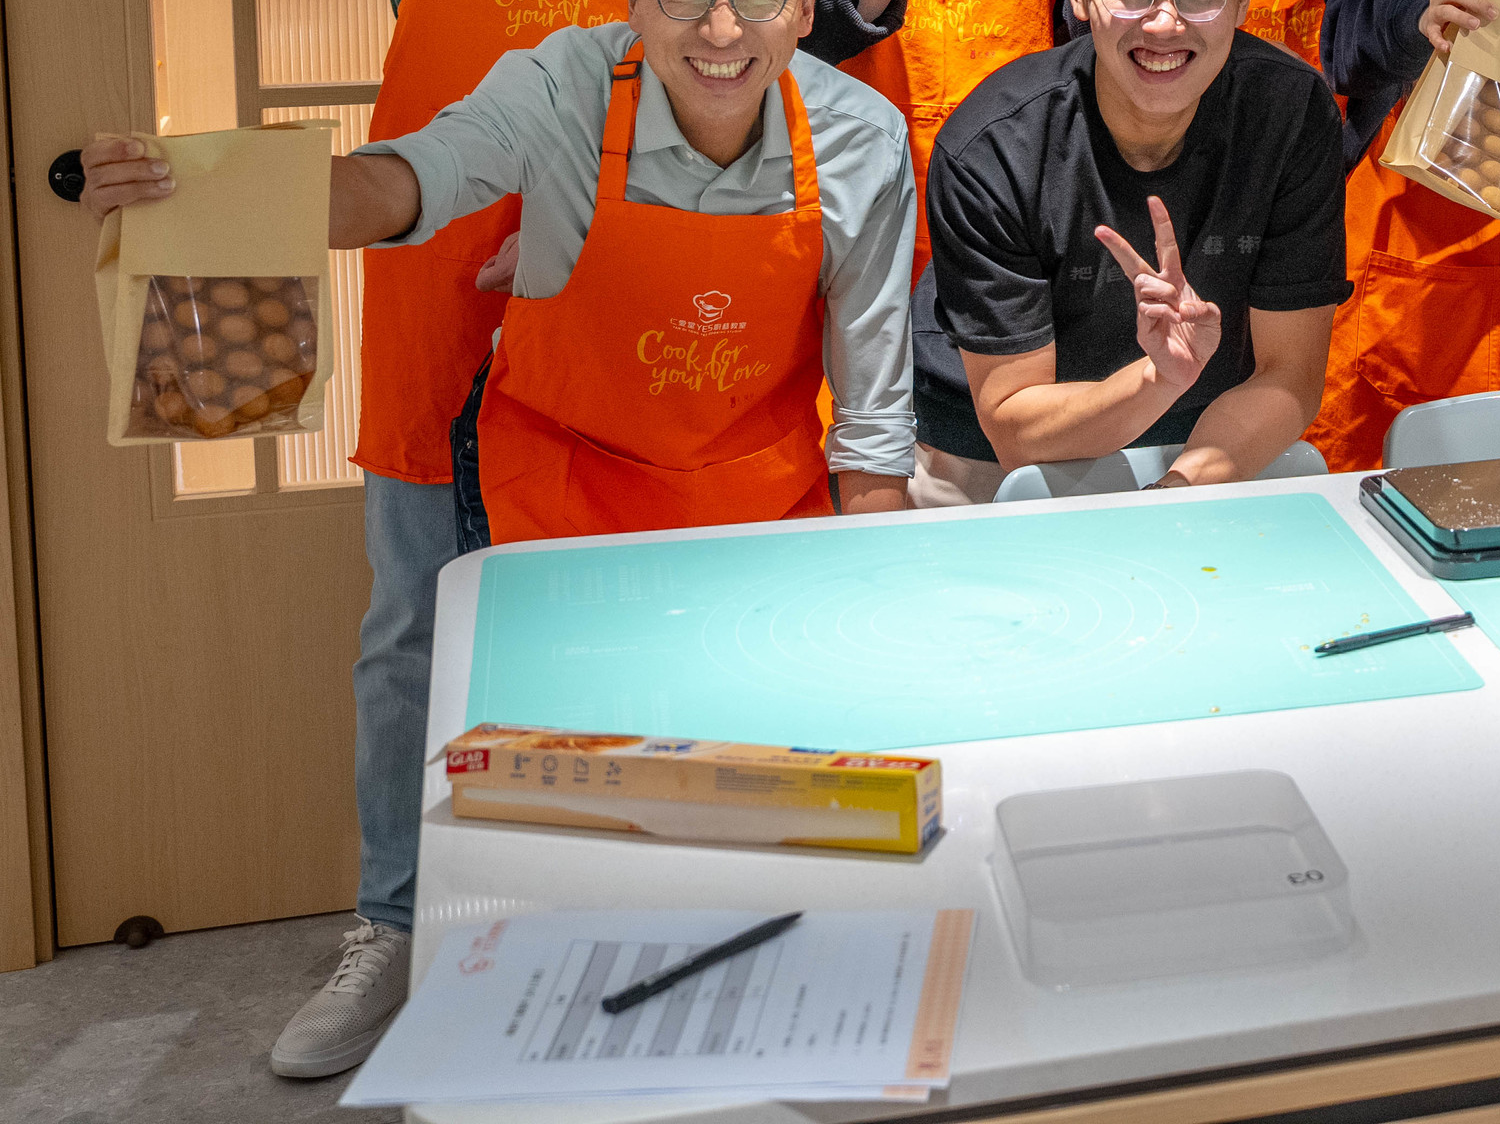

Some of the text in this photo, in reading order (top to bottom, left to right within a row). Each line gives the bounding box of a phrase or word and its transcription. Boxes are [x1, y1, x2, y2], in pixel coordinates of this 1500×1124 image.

[505, 3, 622, 37] your Lov
[903, 14, 1009, 43] your Love
[637, 329, 748, 380] Cook for
[649, 360, 771, 396] your Love
